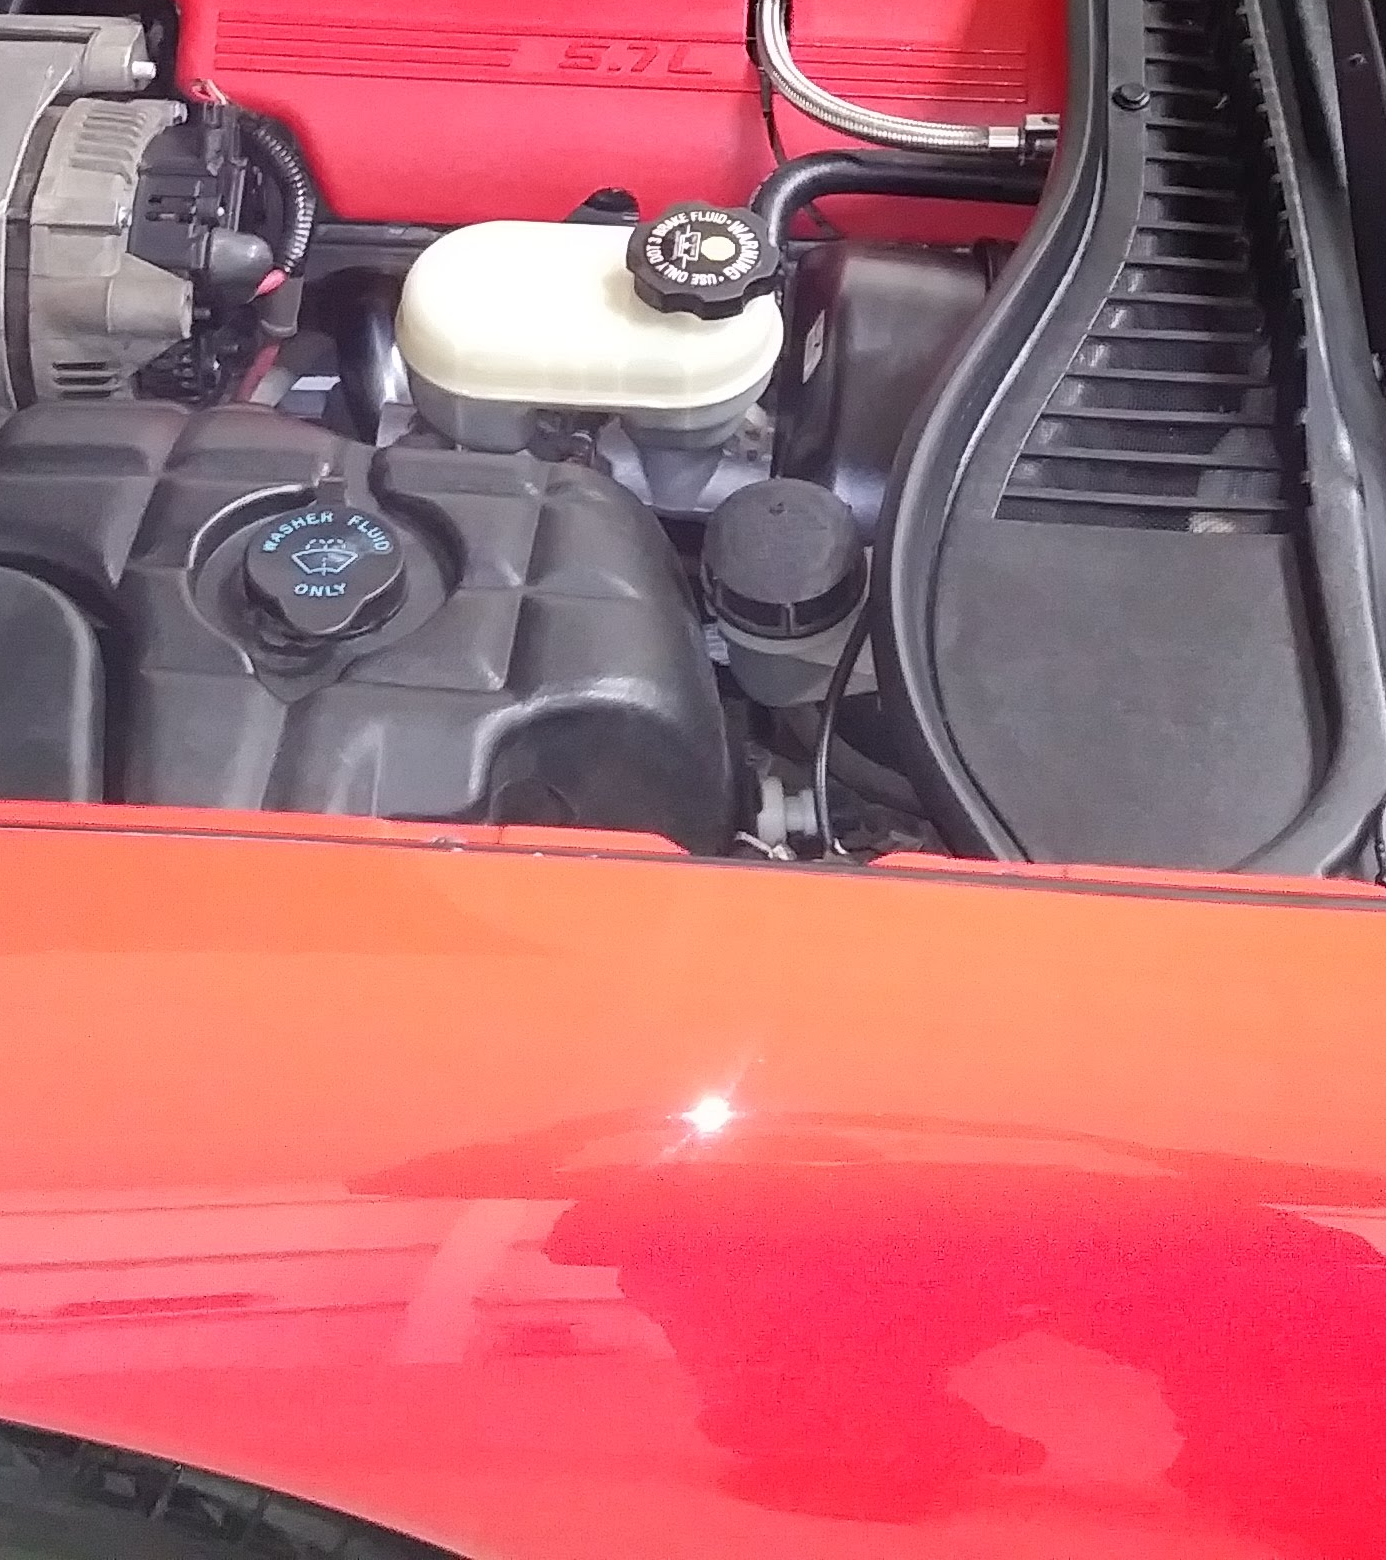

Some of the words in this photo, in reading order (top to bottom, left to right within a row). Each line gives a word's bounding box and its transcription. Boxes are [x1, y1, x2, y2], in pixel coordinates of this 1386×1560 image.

[558, 43, 713, 75] 5.7L
[652, 212, 688, 236] BRAKE
[690, 210, 728, 225] FLUID
[723, 220, 759, 280] WARNING
[655, 262, 688, 284] ONLY
[691, 274, 718, 286] USE
[263, 511, 334, 553] WASHER
[347, 514, 391, 553] FLUID
[294, 582, 347, 598] ONLY
